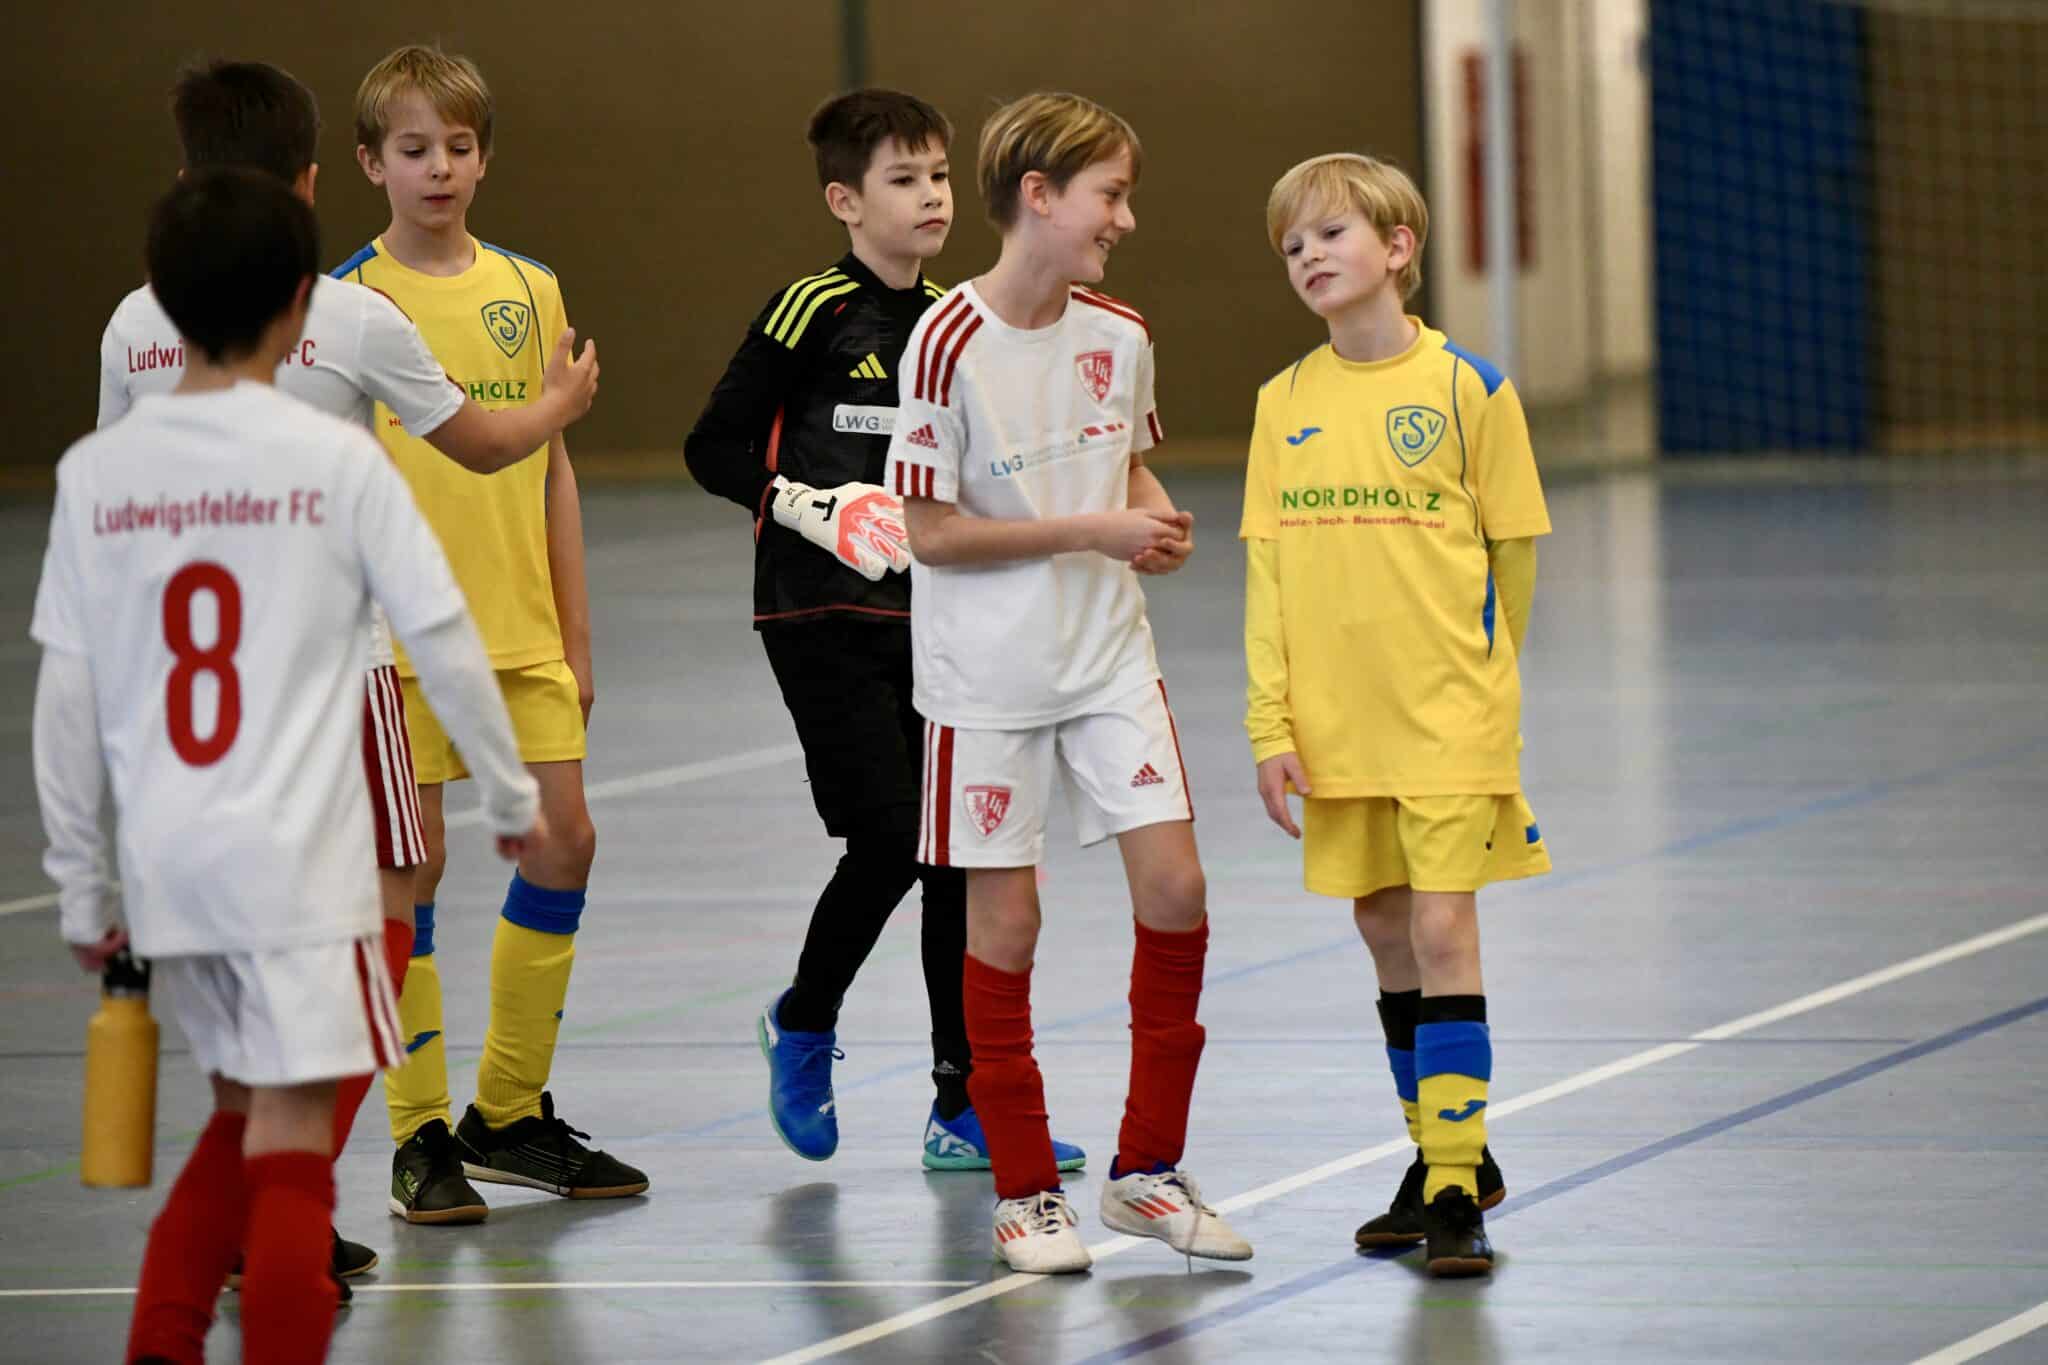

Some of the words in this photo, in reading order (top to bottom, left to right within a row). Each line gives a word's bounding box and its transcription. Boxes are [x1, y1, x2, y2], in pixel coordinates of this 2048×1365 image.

[470, 382, 527, 400] HOLZ
[835, 414, 880, 430] LWG
[1393, 411, 1440, 449] FSV
[94, 488, 279, 537] Ludwigsfelder
[288, 488, 325, 526] FC
[1281, 488, 1441, 511] NORDHOLZ
[162, 560, 243, 770] 8
